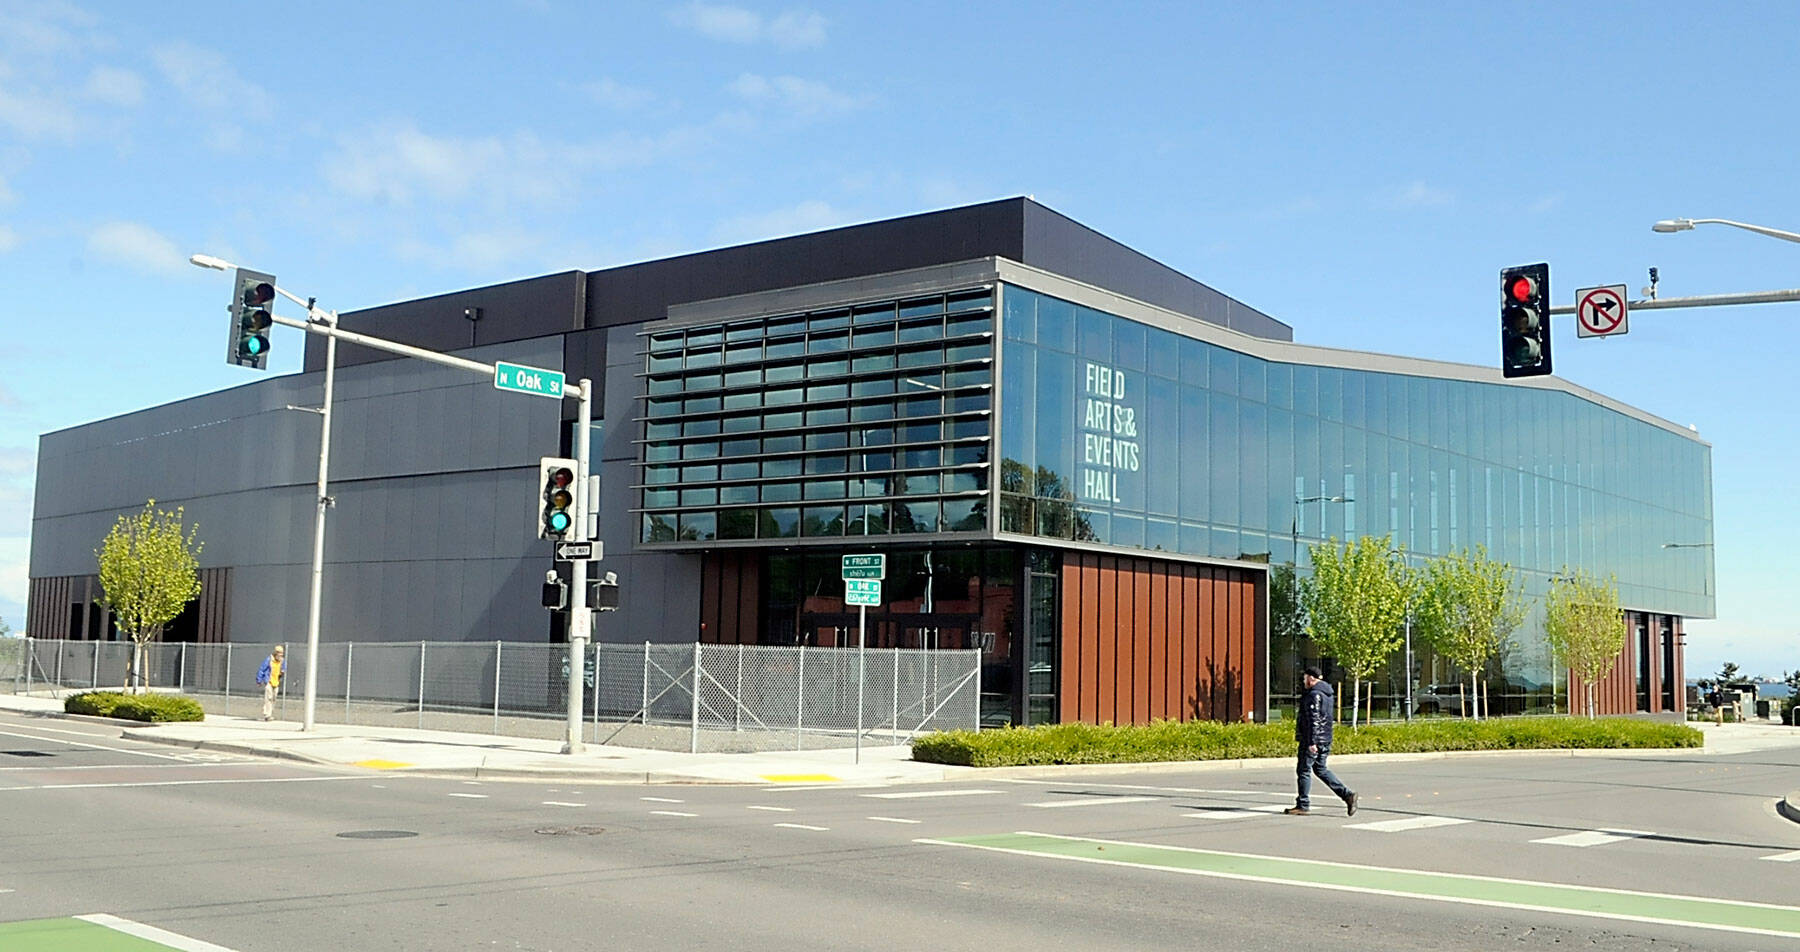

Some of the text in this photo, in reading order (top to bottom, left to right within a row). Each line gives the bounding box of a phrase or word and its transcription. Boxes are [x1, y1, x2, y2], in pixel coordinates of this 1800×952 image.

[500, 370, 560, 393] N Oak St
[1086, 363, 1125, 400] FIELD
[1085, 398, 1137, 437] ARTS &
[1085, 433, 1139, 472] EVENTS
[1084, 468, 1121, 503] HALL
[566, 546, 588, 555] ONE WAY
[852, 557, 871, 565] FRONT
